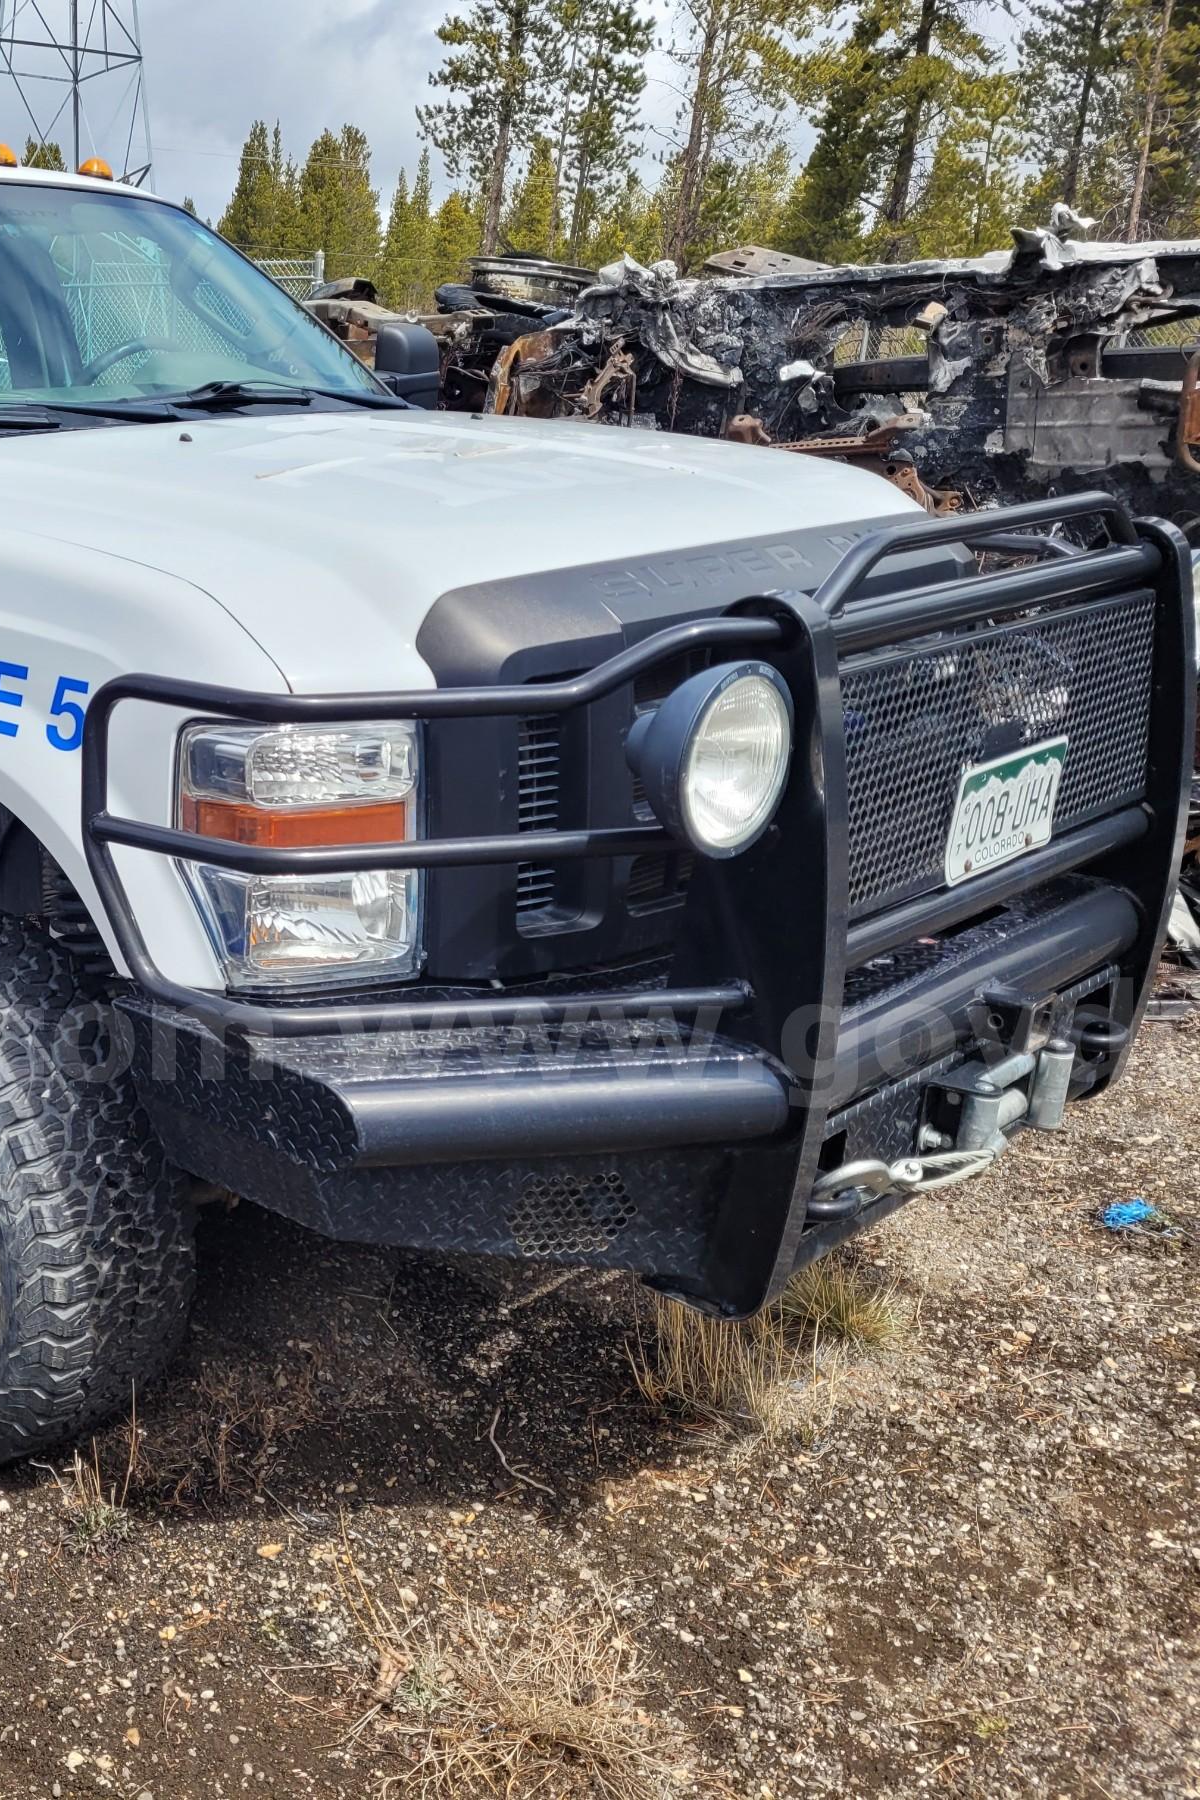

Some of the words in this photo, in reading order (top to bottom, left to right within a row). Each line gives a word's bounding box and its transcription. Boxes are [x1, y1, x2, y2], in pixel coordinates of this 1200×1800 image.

[590, 543, 815, 598] SUPER
[45, 675, 90, 752] 5
[974, 830, 1025, 864] COLORADO
